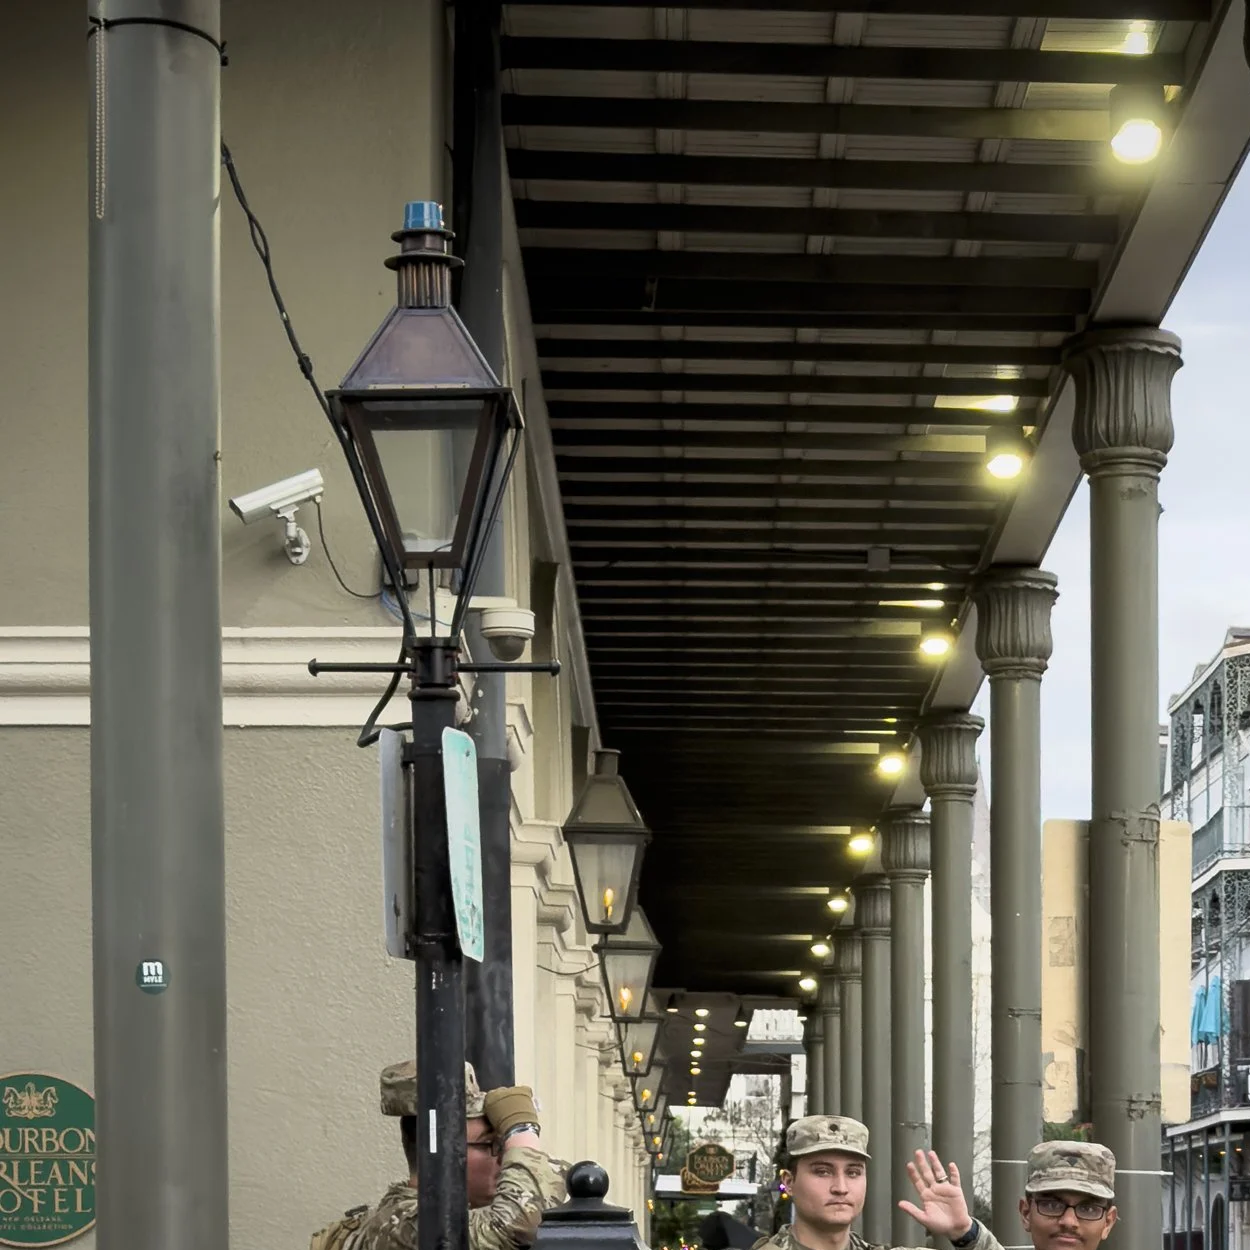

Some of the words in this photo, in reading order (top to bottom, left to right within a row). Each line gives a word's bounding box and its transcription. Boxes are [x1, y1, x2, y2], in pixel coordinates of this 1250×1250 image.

[0, 1127, 96, 1153] URBON
[0, 1159, 96, 1187] RLEAN
[0, 1187, 93, 1214] OTEL
